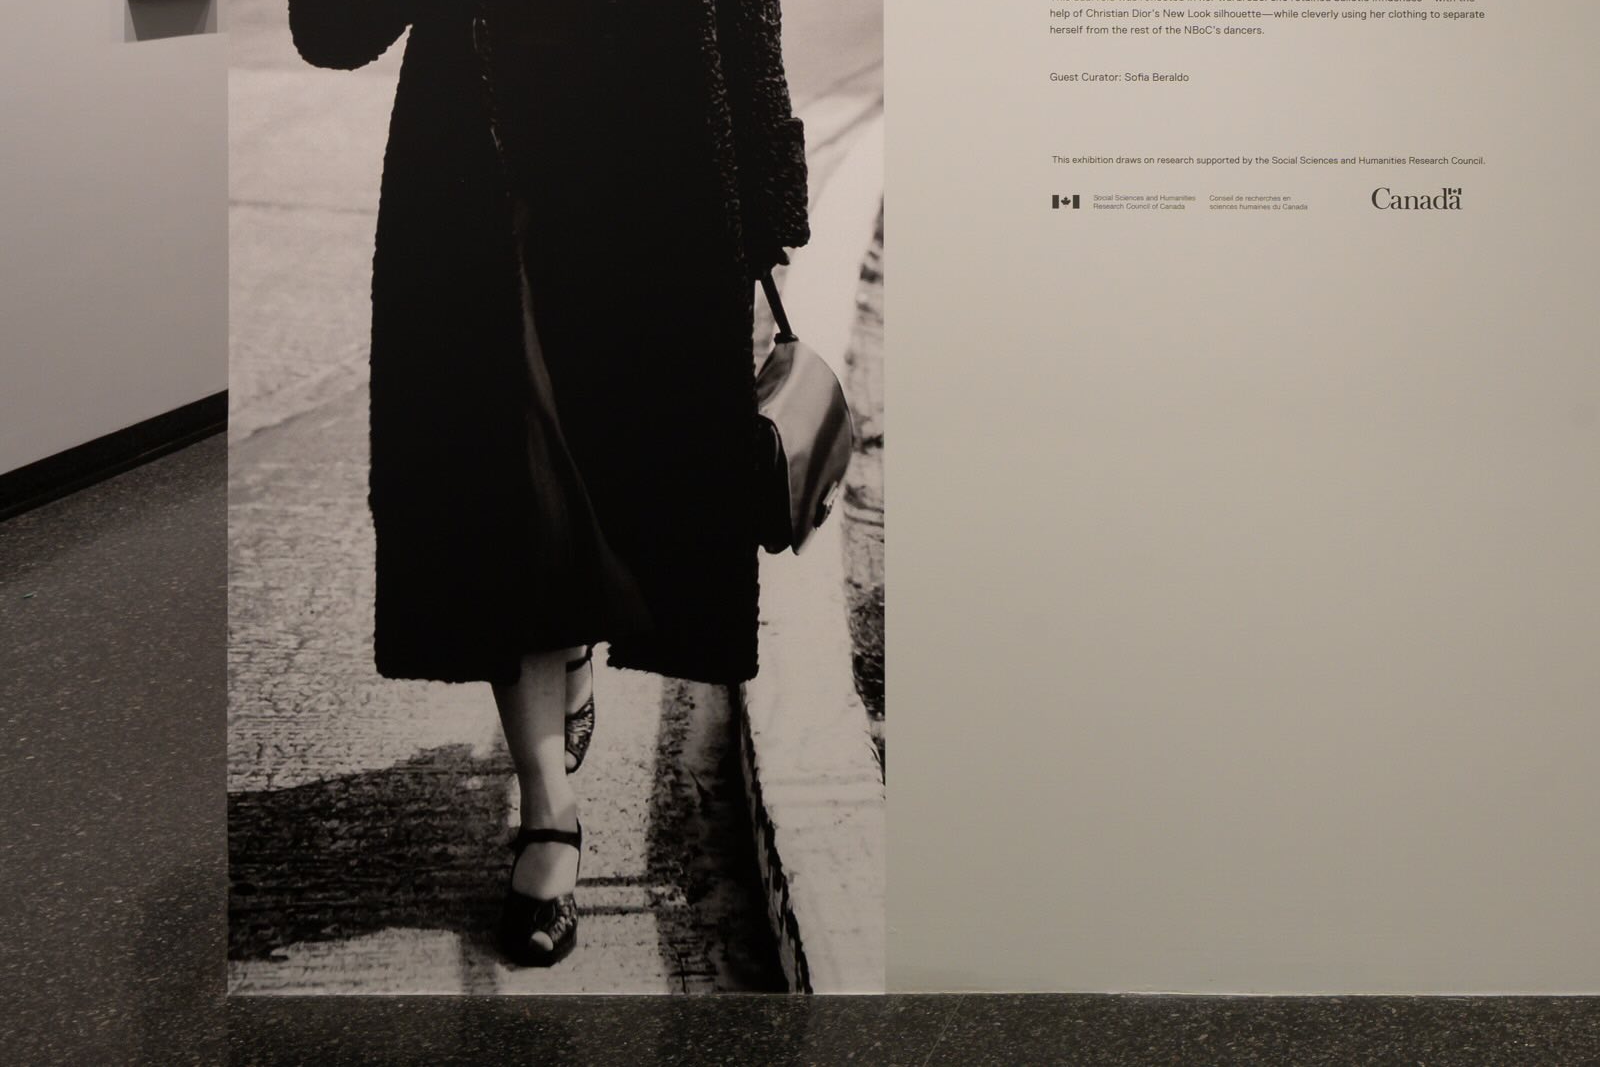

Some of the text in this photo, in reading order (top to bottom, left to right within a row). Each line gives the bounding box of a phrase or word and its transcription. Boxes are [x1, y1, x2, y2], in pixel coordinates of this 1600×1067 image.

[1050, 73, 1189, 81] Guest Curator: Sofia Beraldo
[1197, 157, 1240, 165] supported
[1242, 157, 1253, 165] by
[1272, 156, 1297, 164] Social
[1300, 156, 1338, 164] Sciences
[1093, 194, 1196, 202] Social Sciences and Humanities
[1209, 194, 1291, 202] Conseil de recherches en
[1371, 187, 1460, 210] Canada
